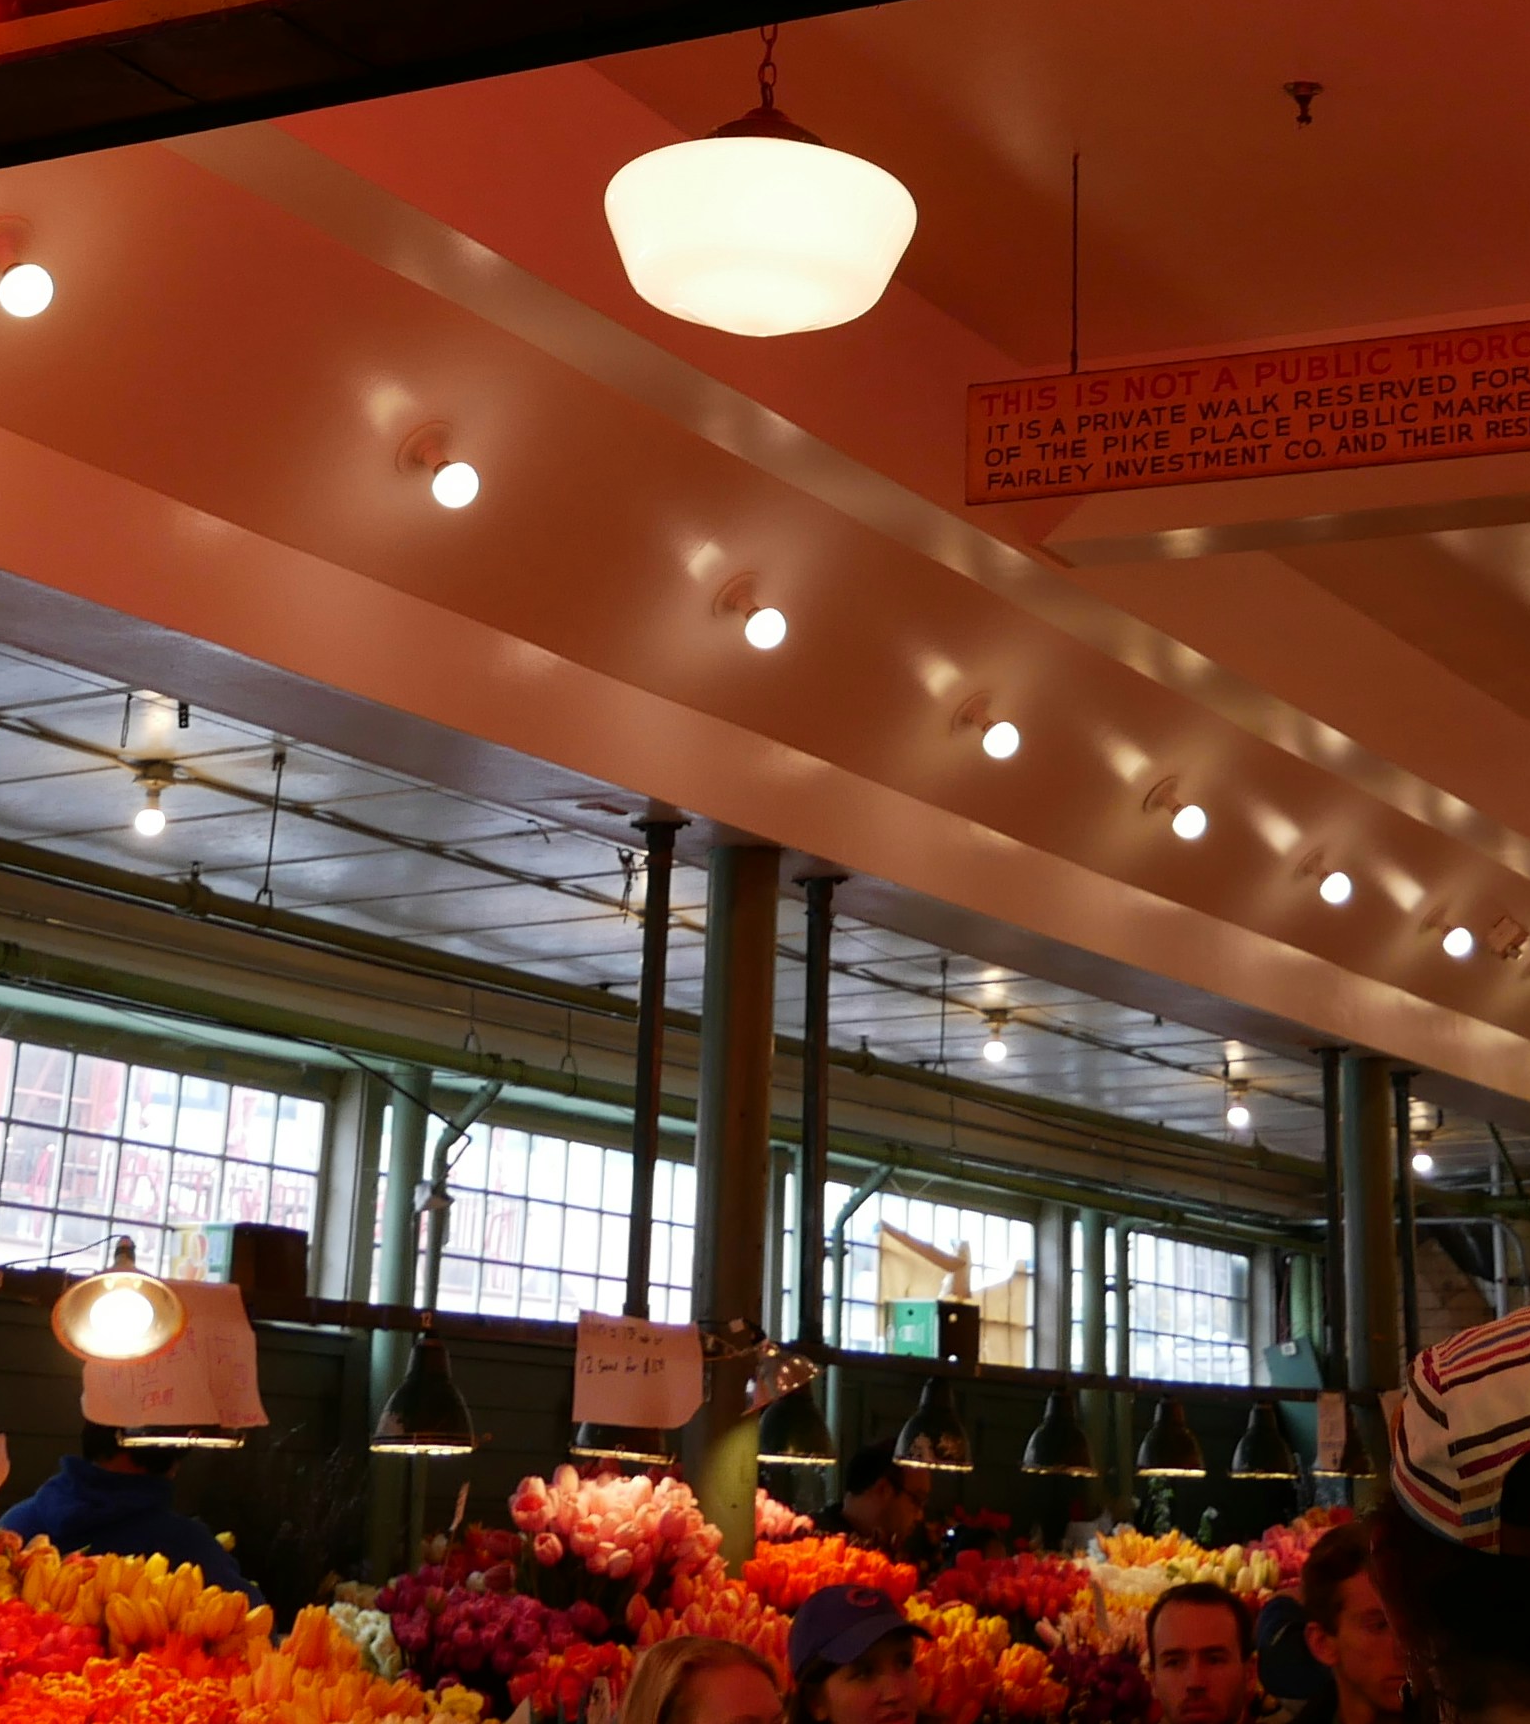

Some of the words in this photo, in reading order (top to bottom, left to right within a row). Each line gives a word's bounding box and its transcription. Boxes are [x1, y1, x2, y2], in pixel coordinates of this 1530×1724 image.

[980, 386, 1057, 416] THIS
[1075, 380, 1110, 407] IS
[1123, 370, 1200, 402] NOT
[1212, 366, 1238, 393] A
[1254, 347, 1392, 388] PUBLIC
[987, 424, 1010, 444] IT
[1018, 419, 1041, 440] IS
[1050, 417, 1066, 437] A
[1077, 403, 1187, 434] PRIVATE
[1198, 393, 1280, 420] WALK
[1293, 374, 1457, 410] RESERVED
[984, 446, 1021, 467] OF
[1036, 439, 1087, 461] THE
[1103, 429, 1171, 455] PIKE
[1189, 416, 1291, 446] PLACE
[1308, 402, 1419, 433] PUBLIC
[987, 462, 1094, 491] FAIRLEY
[1106, 443, 1272, 479] INVESTMENT
[1284, 439, 1326, 461] CO.
[1335, 432, 1388, 455] AND
[1398, 423, 1474, 448] THEIR
